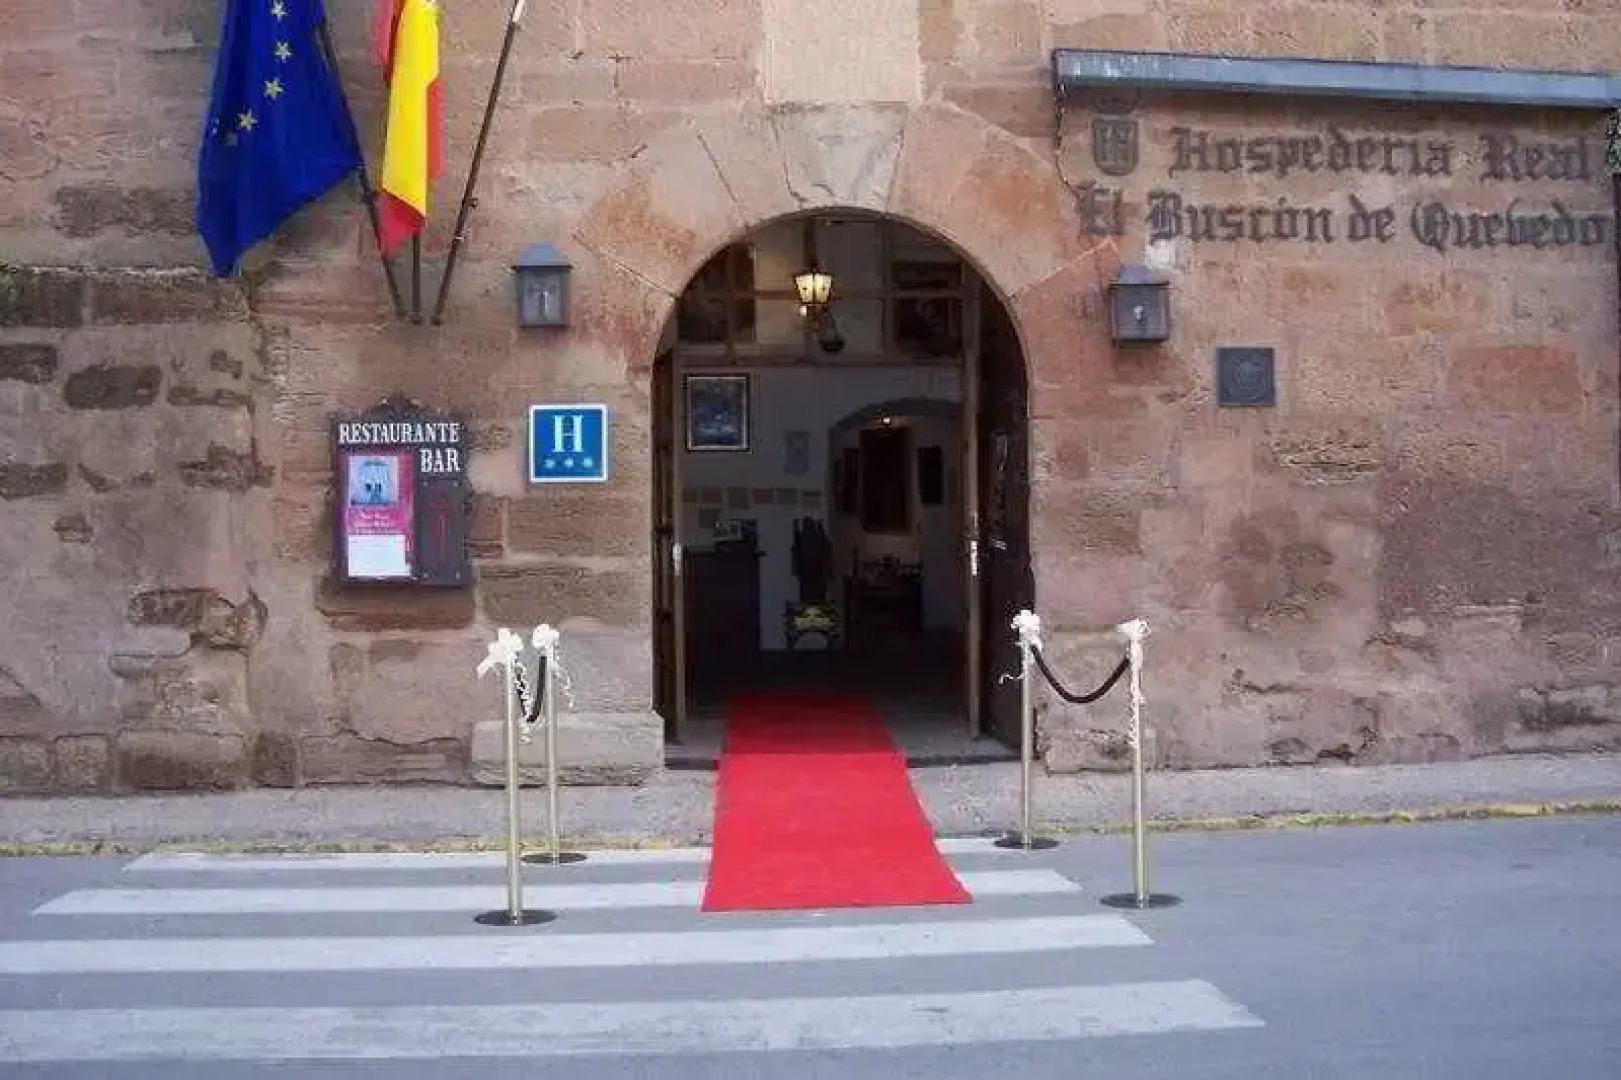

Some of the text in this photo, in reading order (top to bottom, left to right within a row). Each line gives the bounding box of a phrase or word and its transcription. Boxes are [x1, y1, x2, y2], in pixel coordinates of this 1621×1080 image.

[1478, 133, 1591, 184] Real
[1076, 181, 1123, 236] El
[1347, 194, 1395, 243] de
[1409, 197, 1608, 257] Quevedo
[338, 422, 460, 443] RESTAURANTE
[553, 415, 583, 452] H
[420, 448, 460, 472] BAR
